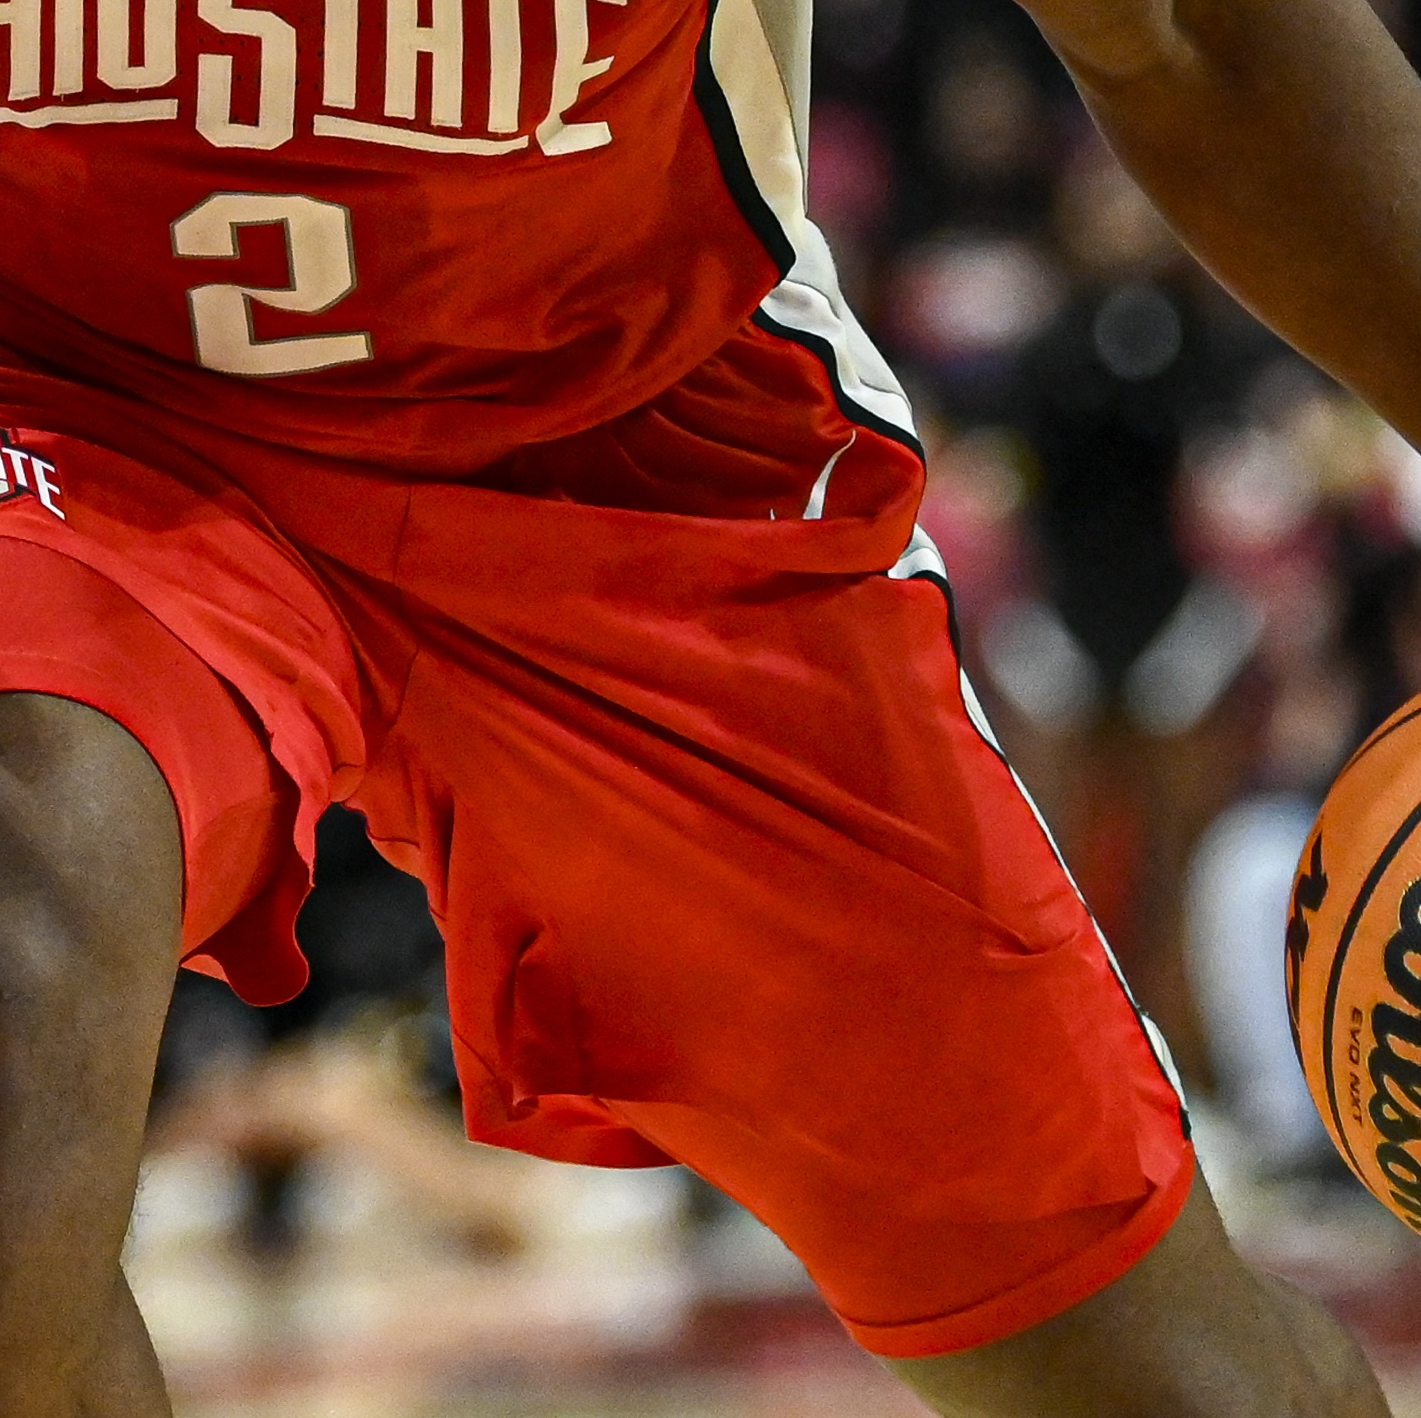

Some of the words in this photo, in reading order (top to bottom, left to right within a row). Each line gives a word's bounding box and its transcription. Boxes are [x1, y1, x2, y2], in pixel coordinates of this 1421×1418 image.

[170, 191, 374, 376] 2
[1348, 1006, 1364, 1066] EVO
[1349, 1071, 1364, 1129] NXT
